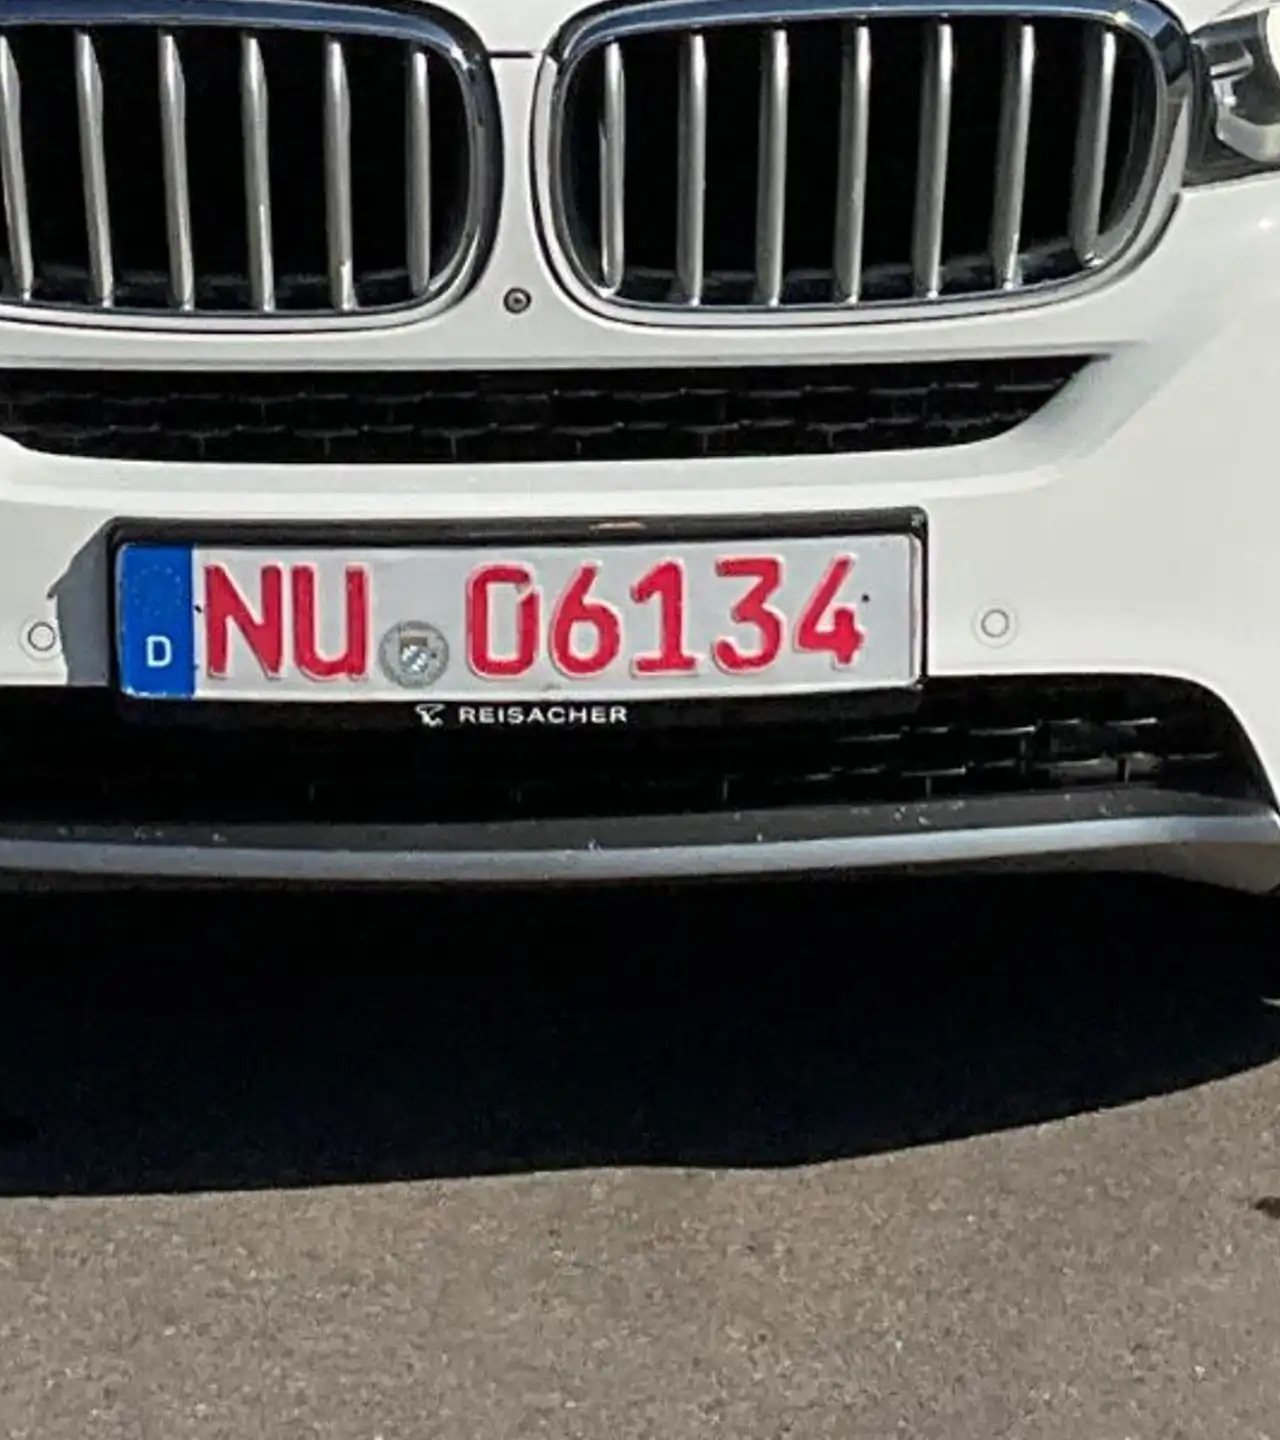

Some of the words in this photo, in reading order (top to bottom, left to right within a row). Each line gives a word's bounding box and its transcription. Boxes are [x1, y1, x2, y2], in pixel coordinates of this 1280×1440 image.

[203, 562, 370, 681] NU
[466, 554, 864, 679] 06134
[145, 635, 173, 669] D
[458, 706, 628, 725] REISACHER
